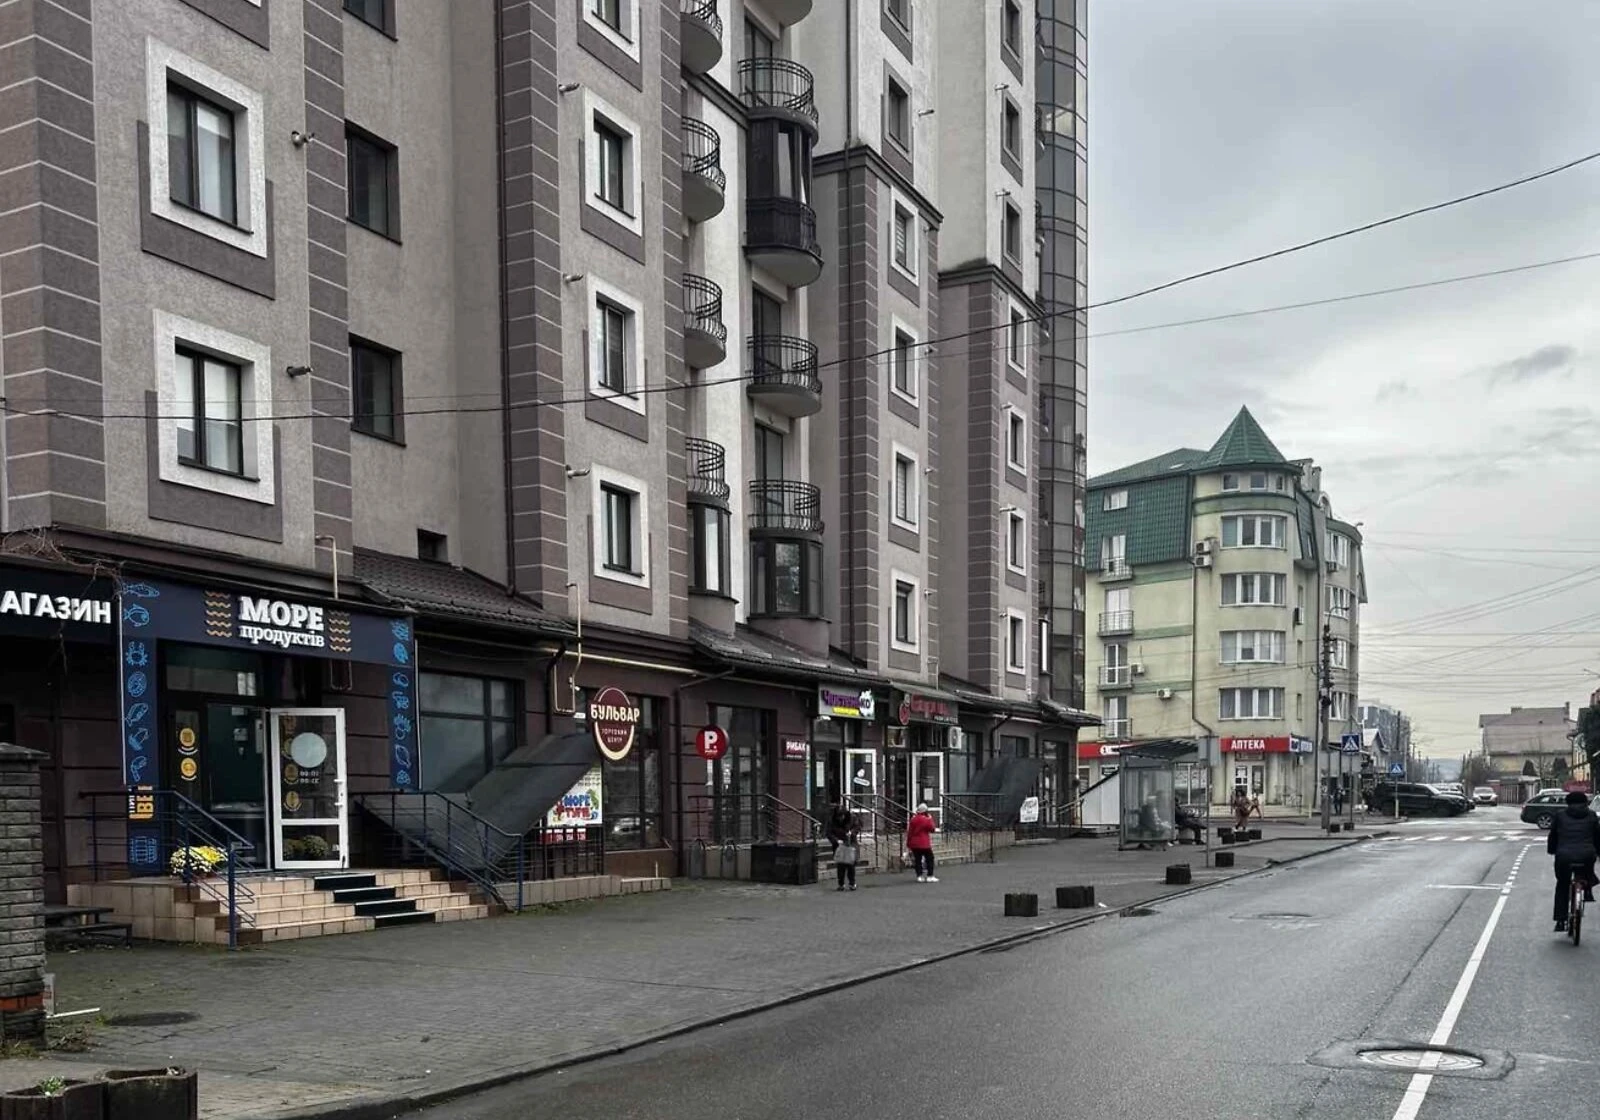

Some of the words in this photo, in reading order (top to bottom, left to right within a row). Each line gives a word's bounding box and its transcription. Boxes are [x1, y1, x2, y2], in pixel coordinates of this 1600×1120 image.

[0, 590, 111, 624] АГАЗИН
[238, 596, 324, 631] МОРЕ
[238, 625, 325, 648] продуктів
[590, 703, 640, 722] БУЛЬВАР
[1231, 740, 1265, 750] АПТЕКА
[564, 794, 591, 806] МОРЕ
